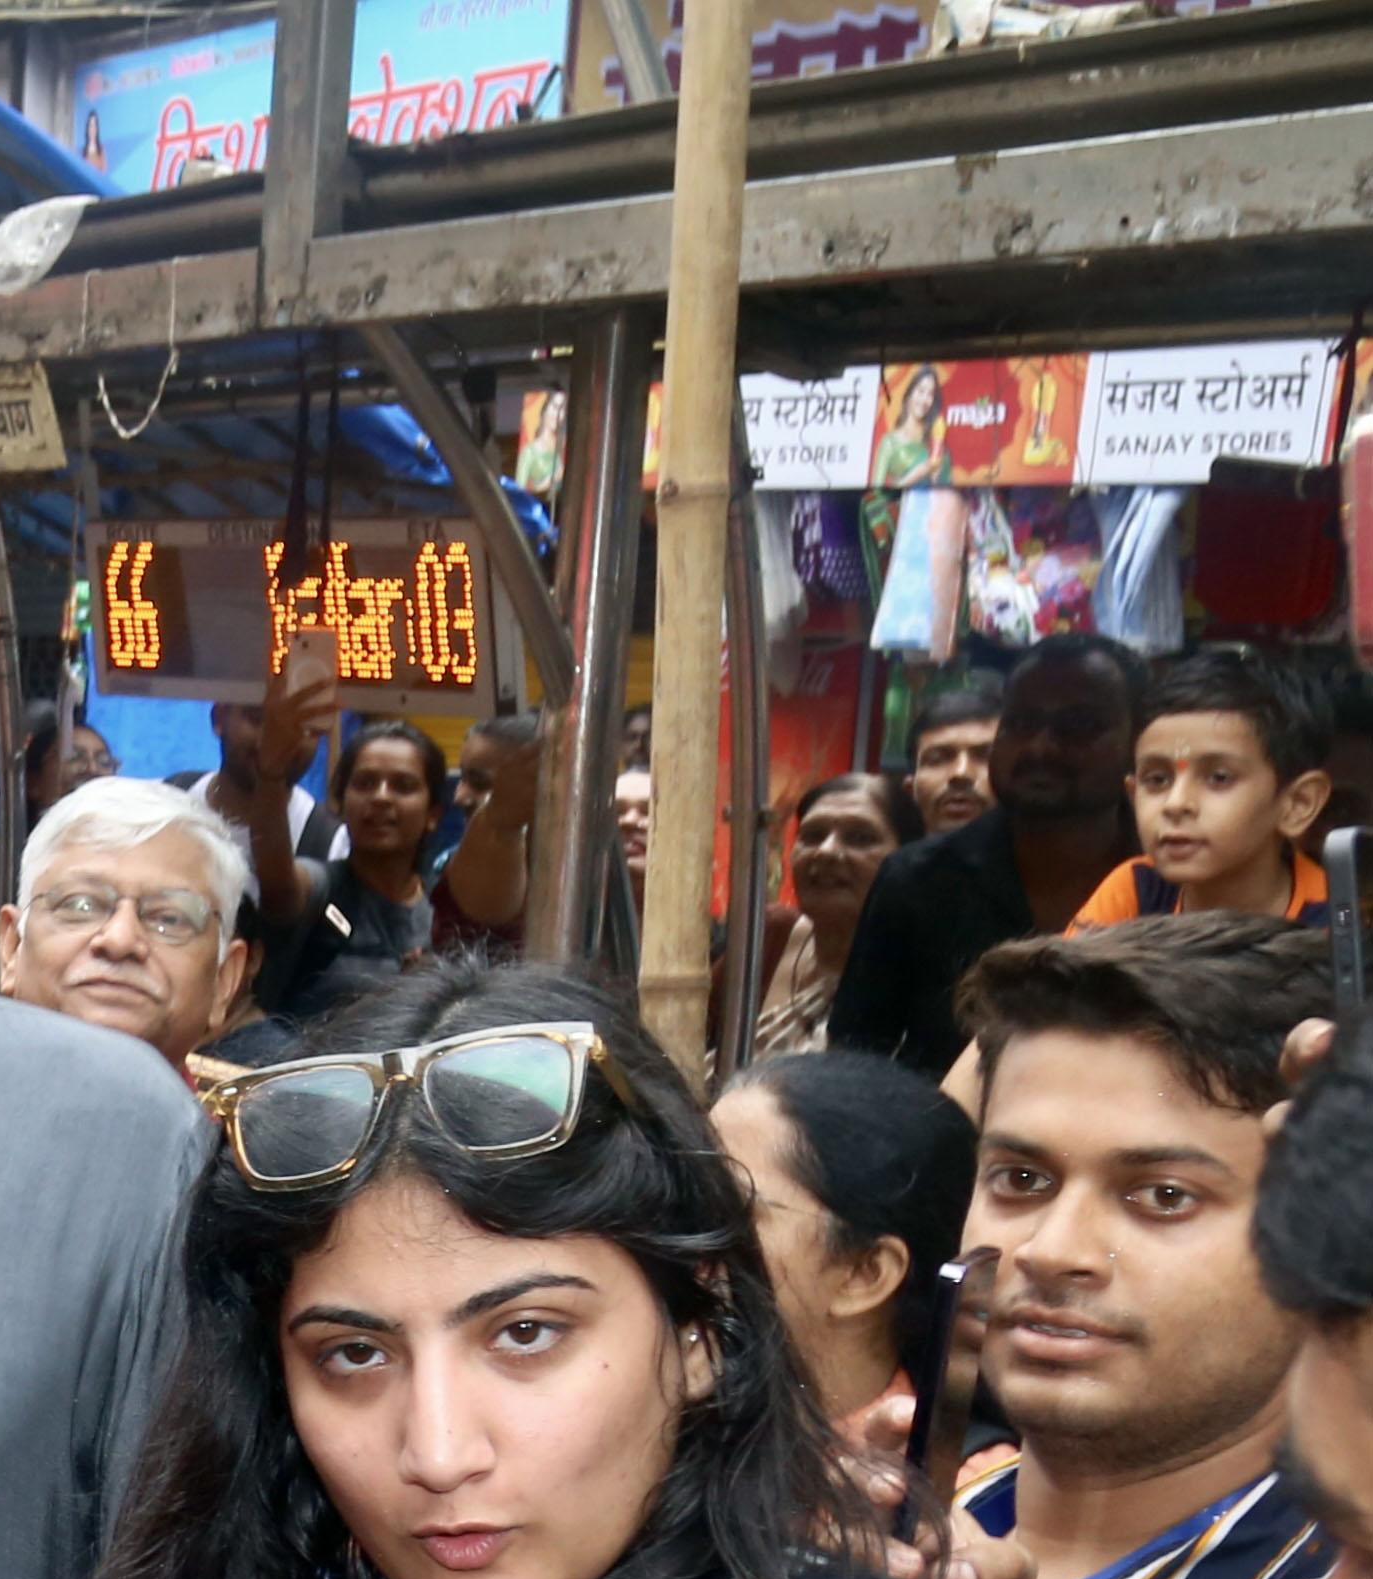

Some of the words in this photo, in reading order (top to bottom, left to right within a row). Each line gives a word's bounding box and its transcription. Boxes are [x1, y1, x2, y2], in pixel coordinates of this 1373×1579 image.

[1105, 370, 1185, 416] संजय
[1195, 354, 1312, 413] स्टोअर्स
[778, 446, 849, 465] STORES
[1105, 433, 1195, 456] SANJAY
[1202, 431, 1293, 456] STORES
